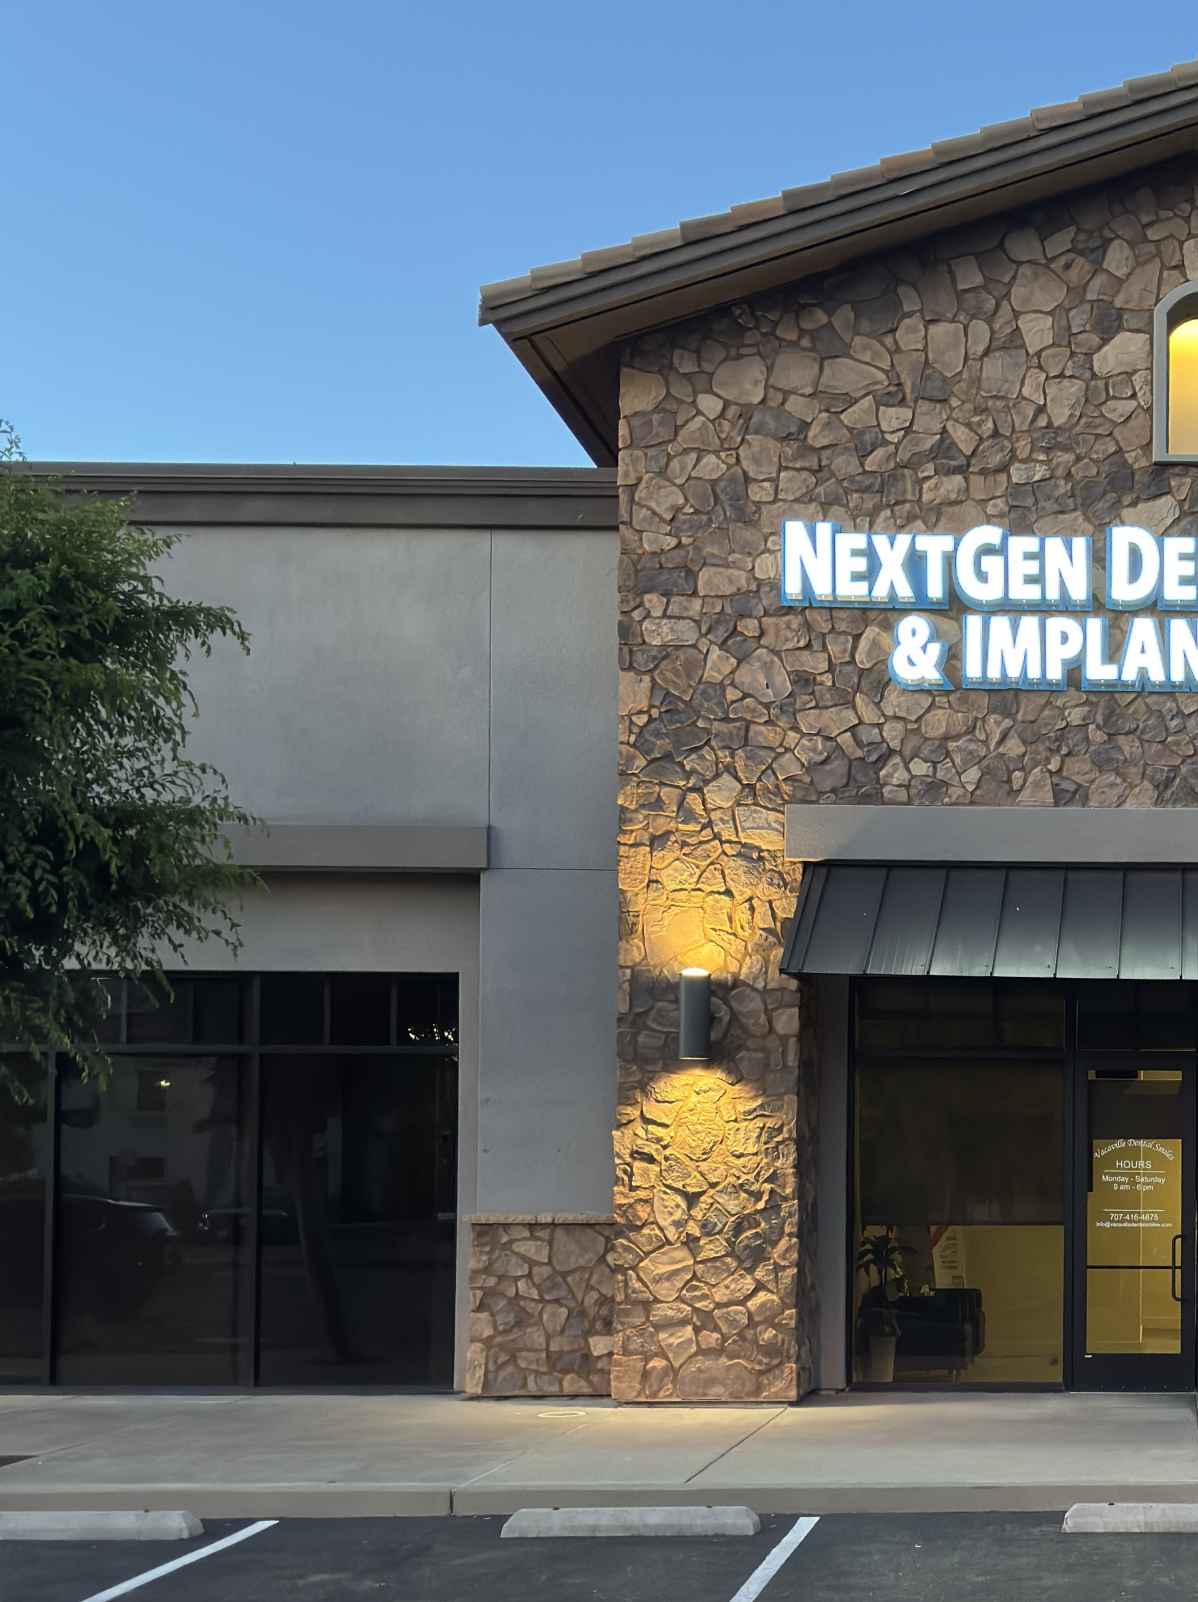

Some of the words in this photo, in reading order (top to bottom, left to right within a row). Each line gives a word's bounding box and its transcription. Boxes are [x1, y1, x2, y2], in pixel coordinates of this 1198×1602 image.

[889, 615, 954, 690] &
[1115, 1160, 1152, 1169] HOURS
[1102, 1174, 1129, 1184] Monday
[1135, 1174, 1167, 1185] Saturday
[1142, 1184, 1154, 1192] pm
